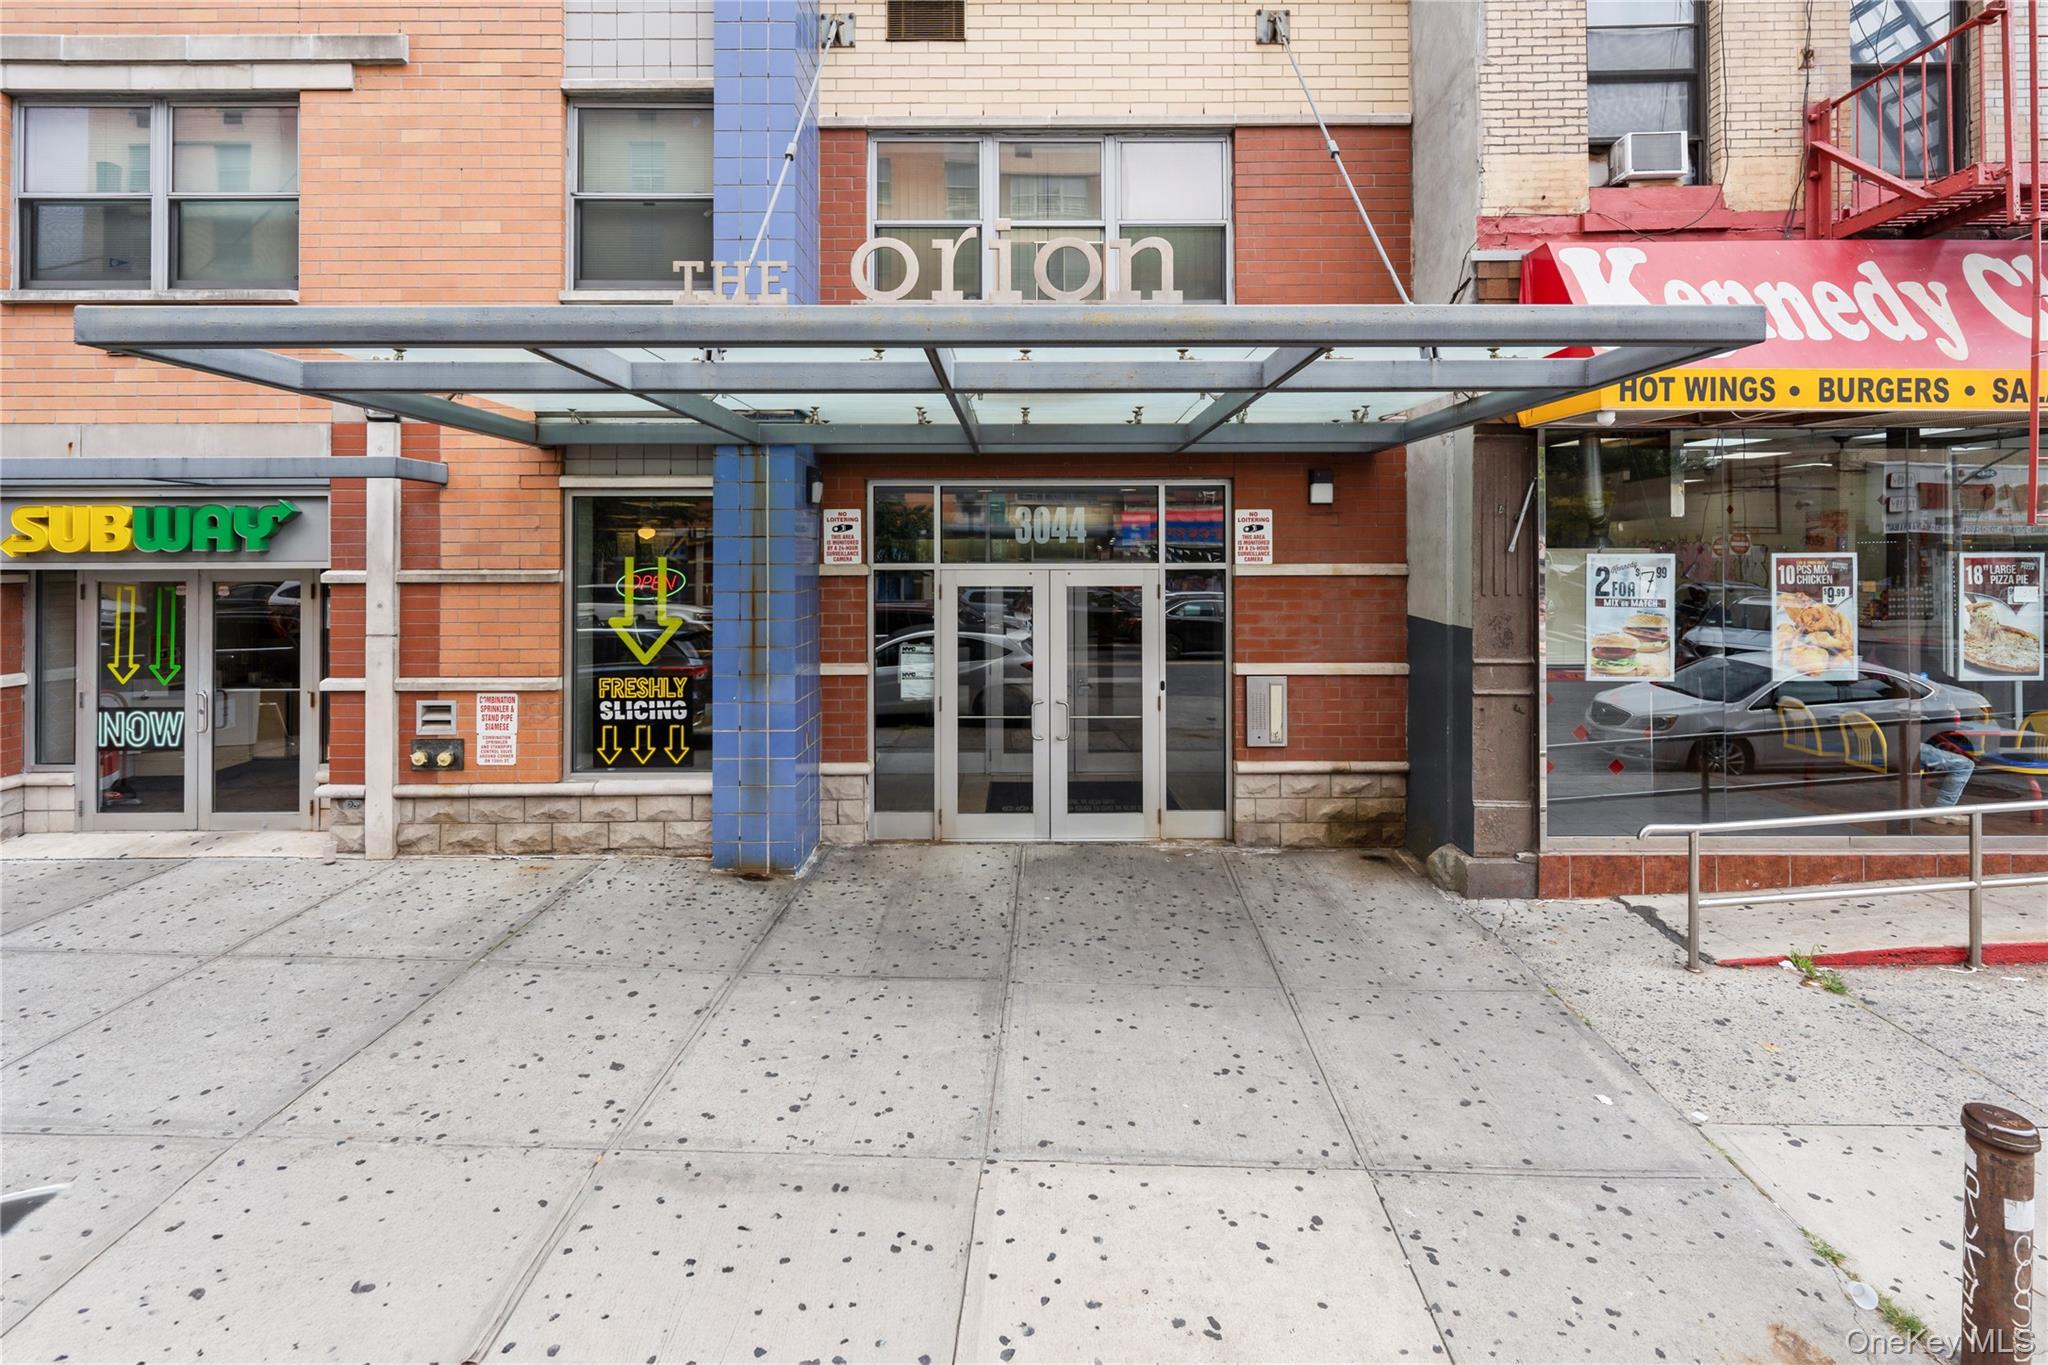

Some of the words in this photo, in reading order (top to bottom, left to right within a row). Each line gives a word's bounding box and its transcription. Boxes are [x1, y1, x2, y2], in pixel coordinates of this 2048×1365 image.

[850, 217, 1184, 305] orion
[672, 260, 789, 305] THE
[1962, 253, 2048, 342] C
[1619, 376, 1676, 402] HOT
[1684, 376, 1776, 403] WINGS
[1818, 377, 1950, 403] BURGERS
[0, 500, 302, 558] SUBWAY
[1015, 506, 1087, 544] 3044
[1778, 564, 1796, 585] 10
[1796, 564, 1812, 574] PCS
[1813, 564, 1829, 574] MIX
[1796, 575, 1833, 584] CHICKEN
[1989, 564, 2016, 574] LARGE
[1990, 575, 2014, 584] PIZZA
[2016, 575, 2029, 584] PIE
[626, 574, 678, 591] OPEN
[1595, 566, 1610, 597] 2
[1612, 581, 1636, 597] FOR
[1604, 599, 1619, 608] MIX
[1630, 599, 1658, 608] MATCH
[1824, 587, 1846, 603] $9.99
[599, 677, 688, 698] FRESHLY
[600, 700, 688, 720] SLICING
[98, 711, 184, 747] NOW
